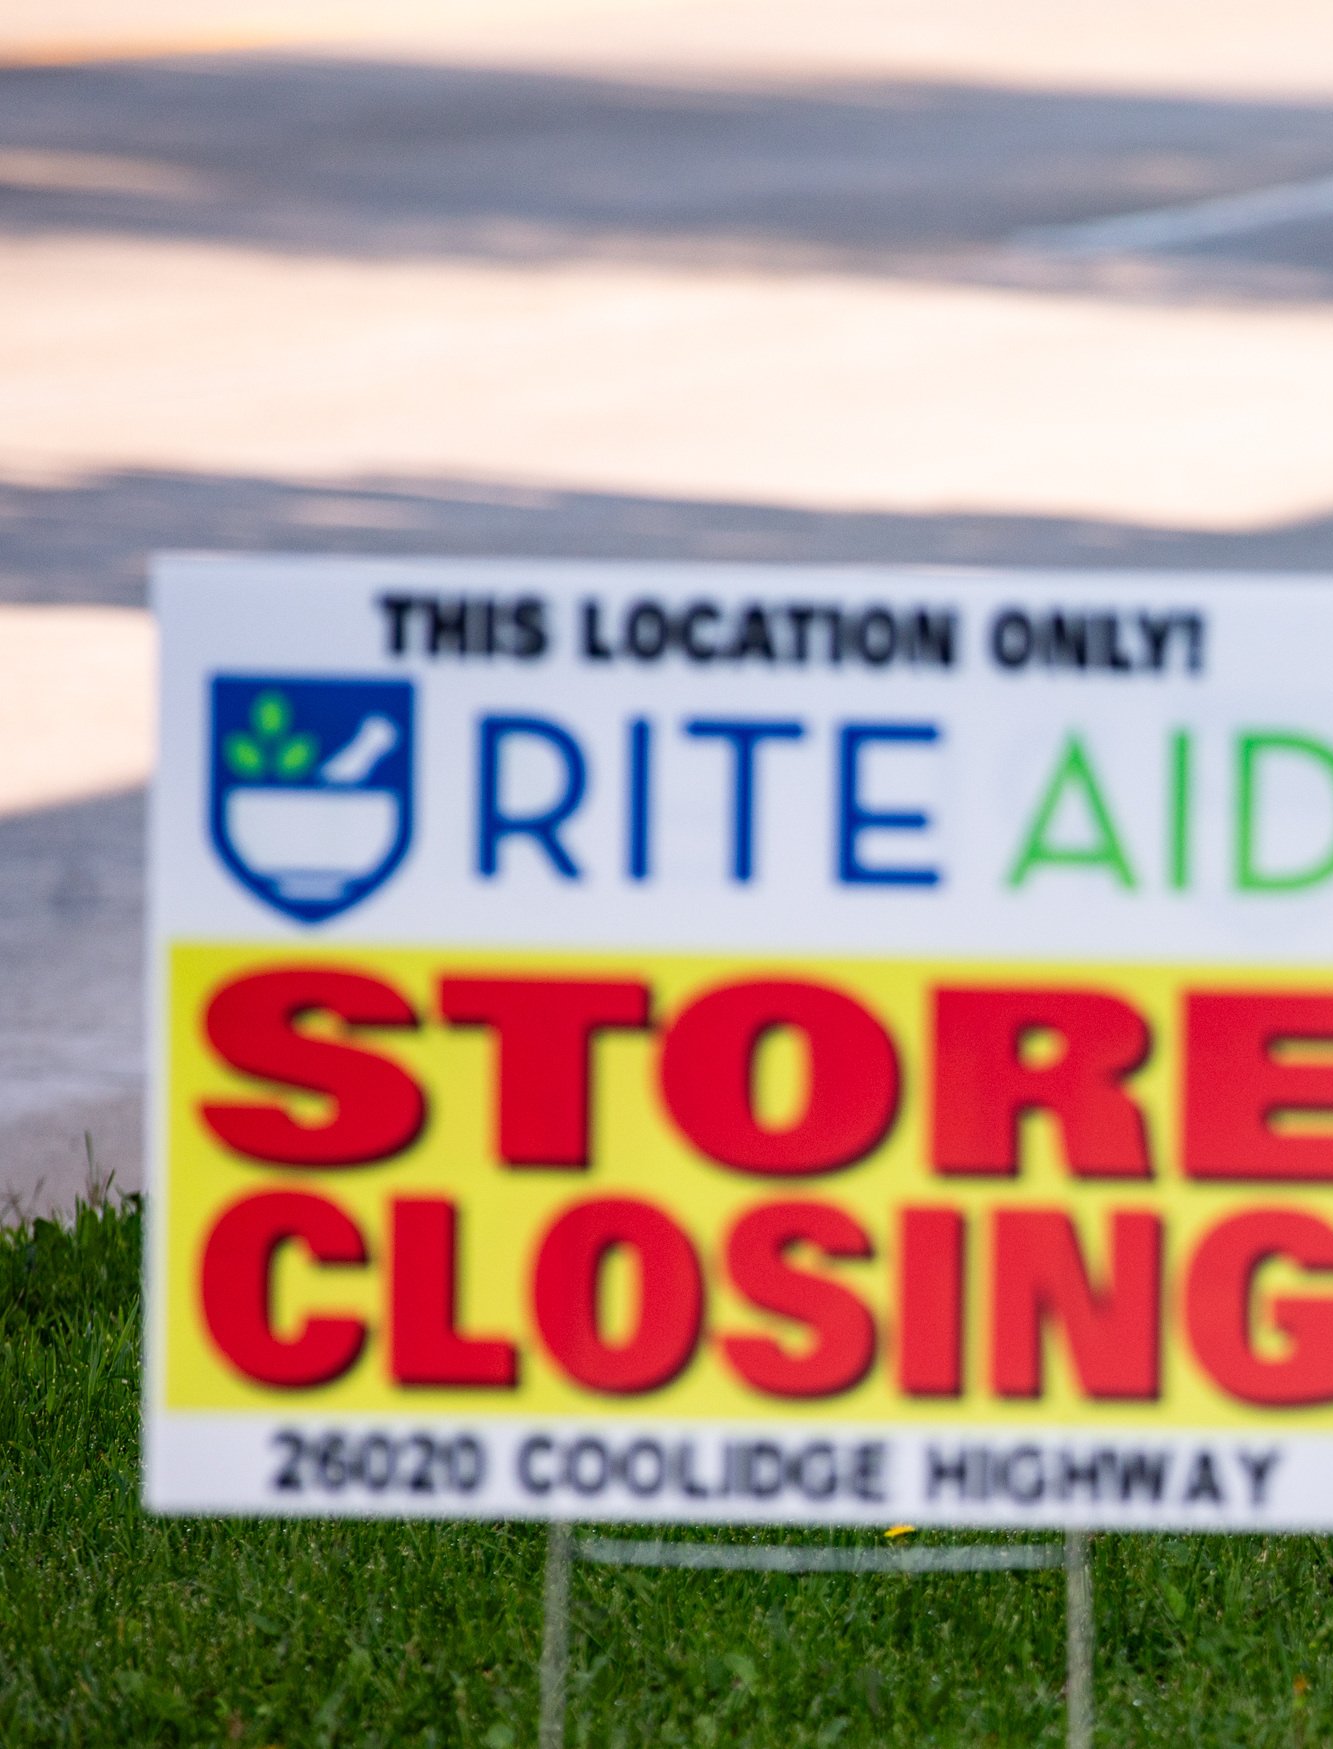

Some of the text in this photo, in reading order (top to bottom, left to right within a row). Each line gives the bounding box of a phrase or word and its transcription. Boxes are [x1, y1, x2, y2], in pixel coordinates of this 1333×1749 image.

[378, 593, 1207, 677] THIS LOCATION ONLY!
[474, 713, 945, 887] RITE
[270, 1429, 1282, 1506] 26020 COOLIDGE HIGHWAY
